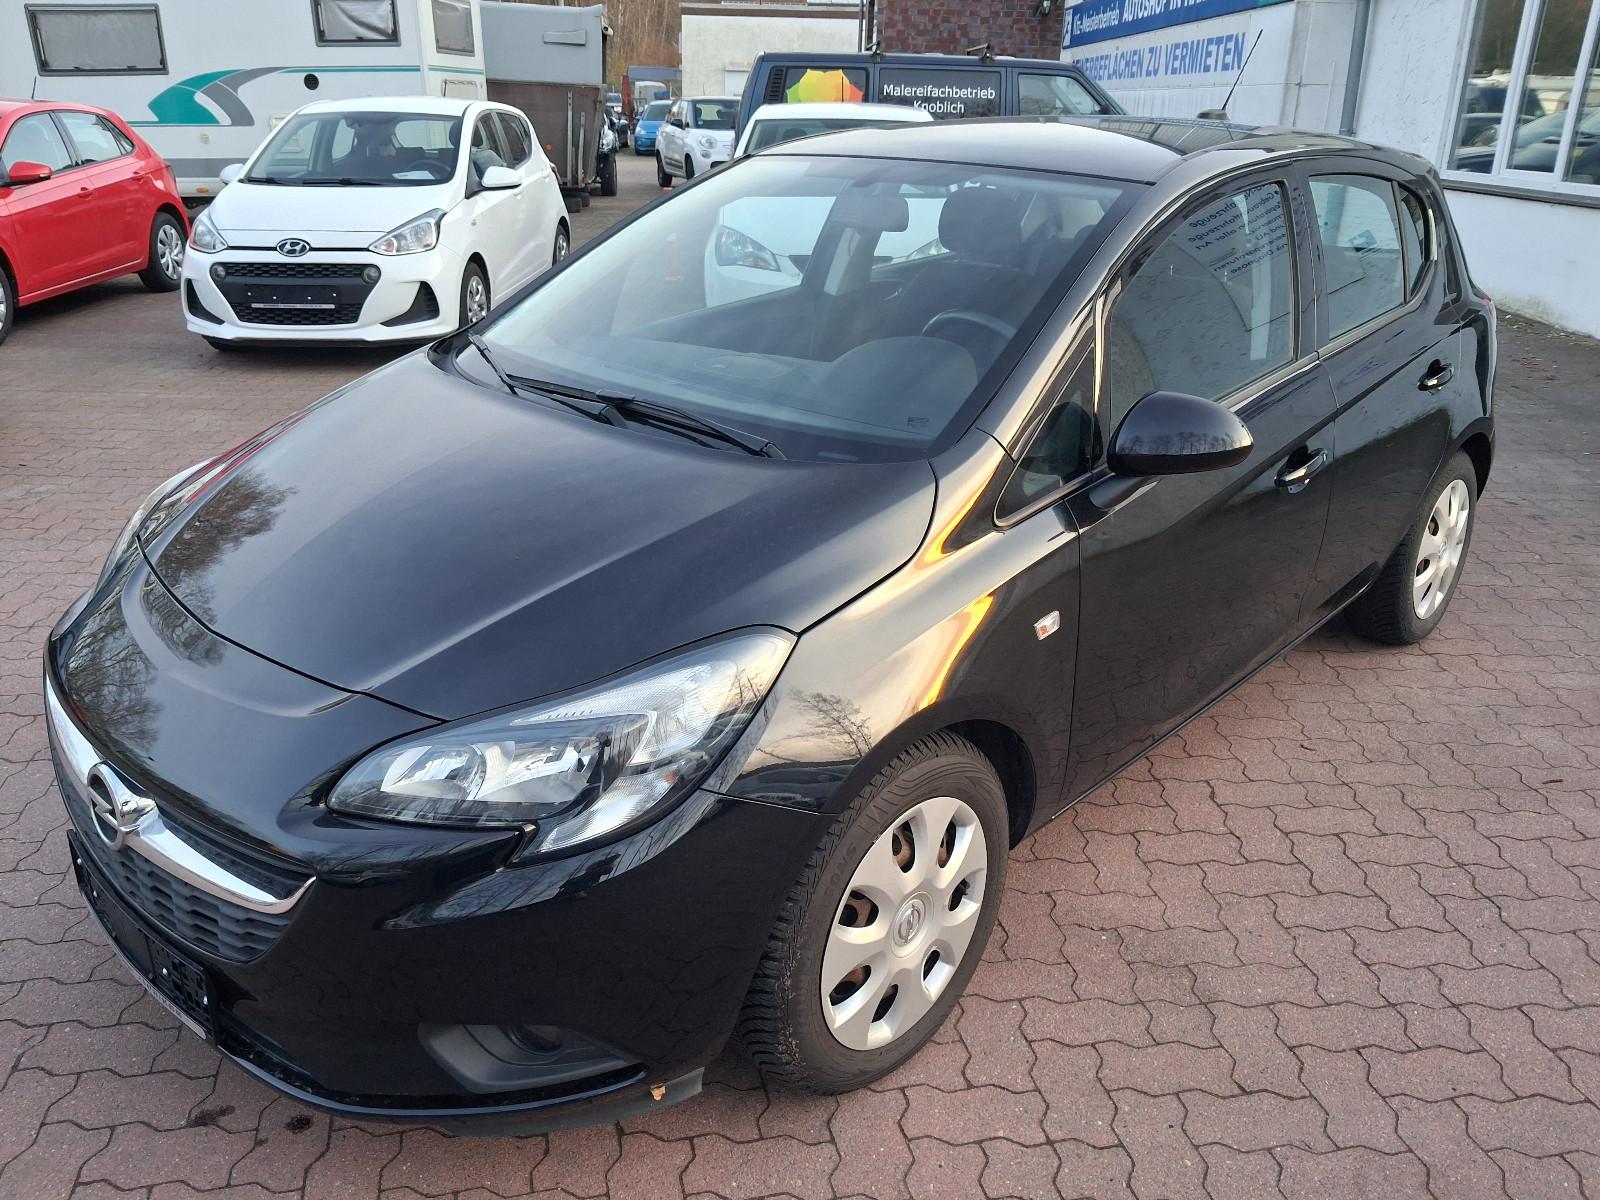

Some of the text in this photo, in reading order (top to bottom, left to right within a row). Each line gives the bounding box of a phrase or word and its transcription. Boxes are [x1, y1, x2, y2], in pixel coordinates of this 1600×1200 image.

[1145, 45, 1162, 77] ZU
[1164, 32, 1246, 75] VERMIETEN
[883, 84, 996, 99] Malereifachbetrieb
[913, 100, 965, 114] Knoblich
